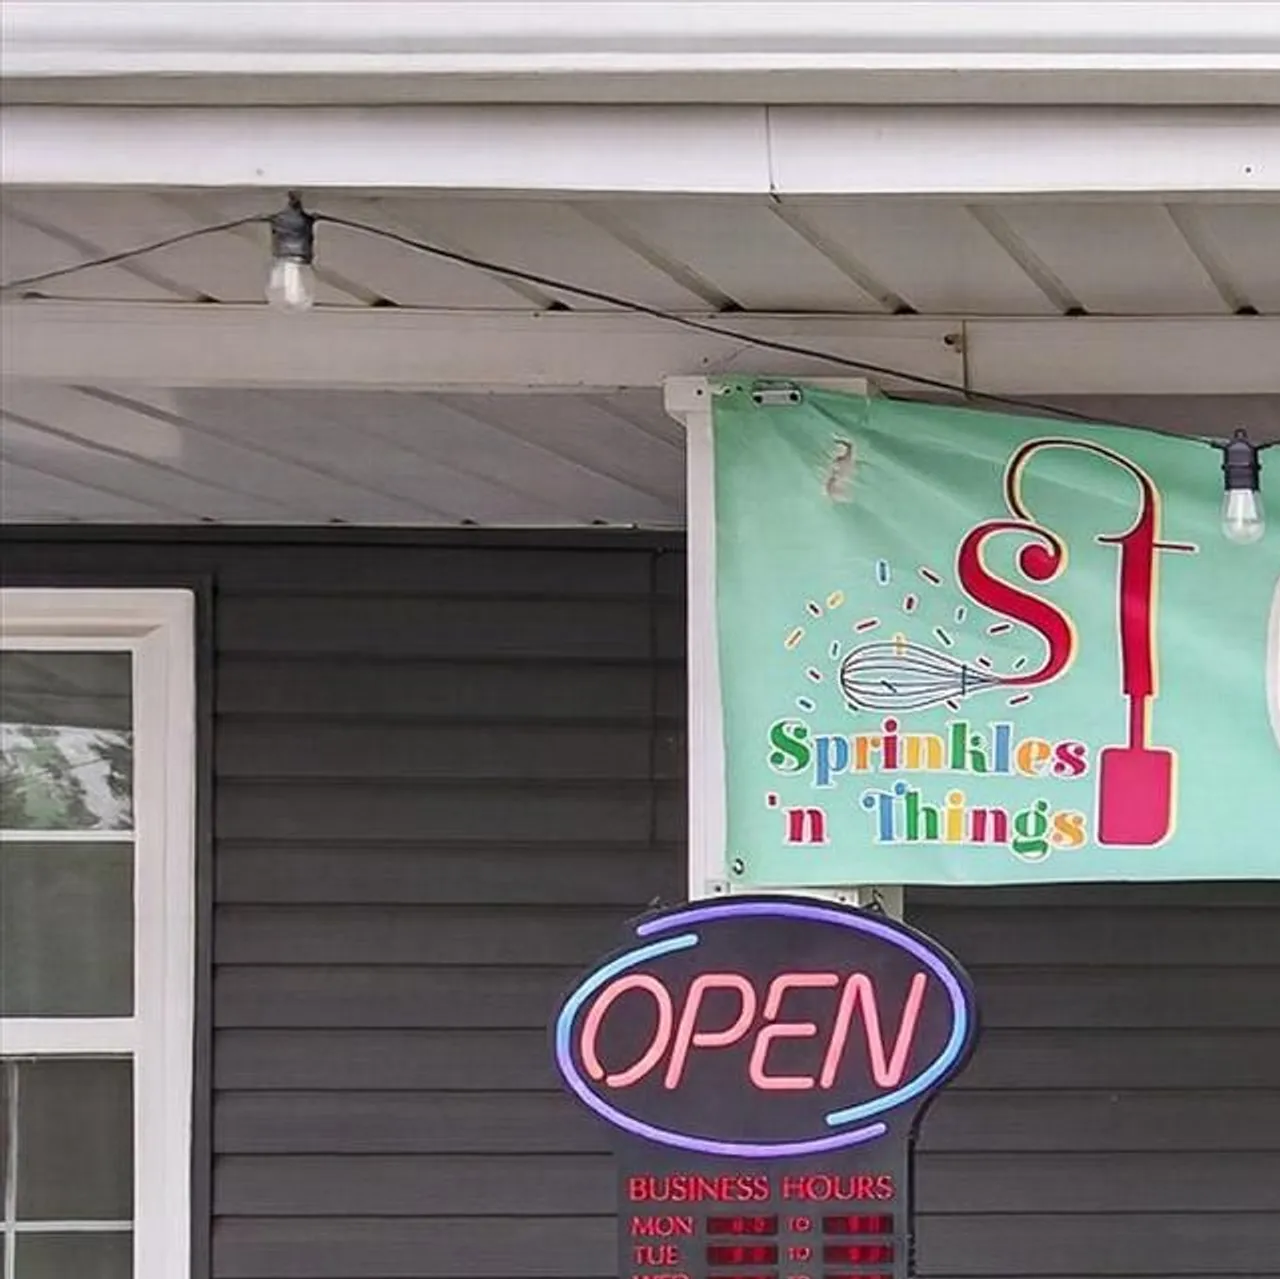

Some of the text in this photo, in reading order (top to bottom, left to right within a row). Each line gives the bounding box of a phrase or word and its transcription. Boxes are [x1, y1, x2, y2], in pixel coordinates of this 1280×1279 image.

[769, 717, 1087, 786] Sprinkles
[861, 781, 1086, 853] Things
[581, 972, 927, 1090] OPEN
[628, 1174, 895, 1201] BUSINESS HOURS
[630, 1215, 694, 1237] MON
[786, 1216, 811, 1233] TO
[633, 1245, 679, 1266] TUE
[786, 1246, 811, 1261] TO
